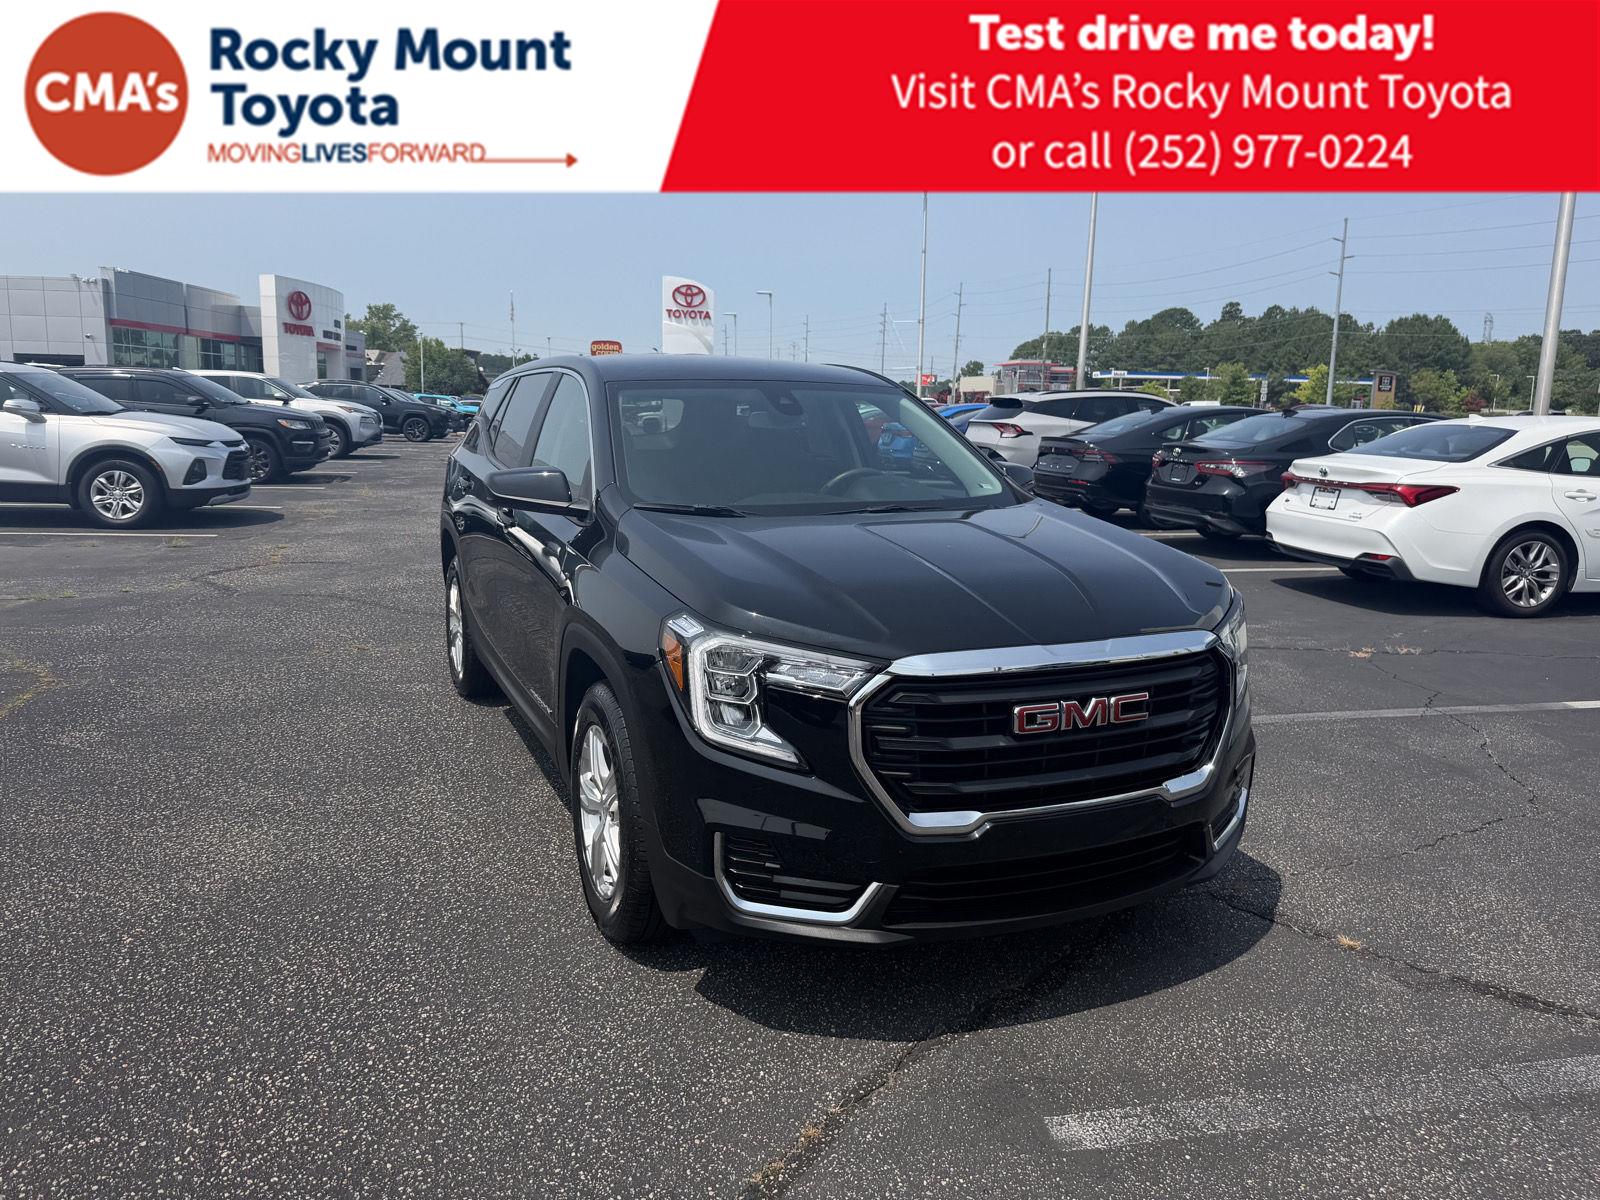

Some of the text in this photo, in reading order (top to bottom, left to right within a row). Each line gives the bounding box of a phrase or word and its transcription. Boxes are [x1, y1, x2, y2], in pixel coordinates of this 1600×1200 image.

[666, 309, 711, 320] TOYOTA
[592, 343, 619, 351] golden
[1012, 691, 1149, 735] GMC
